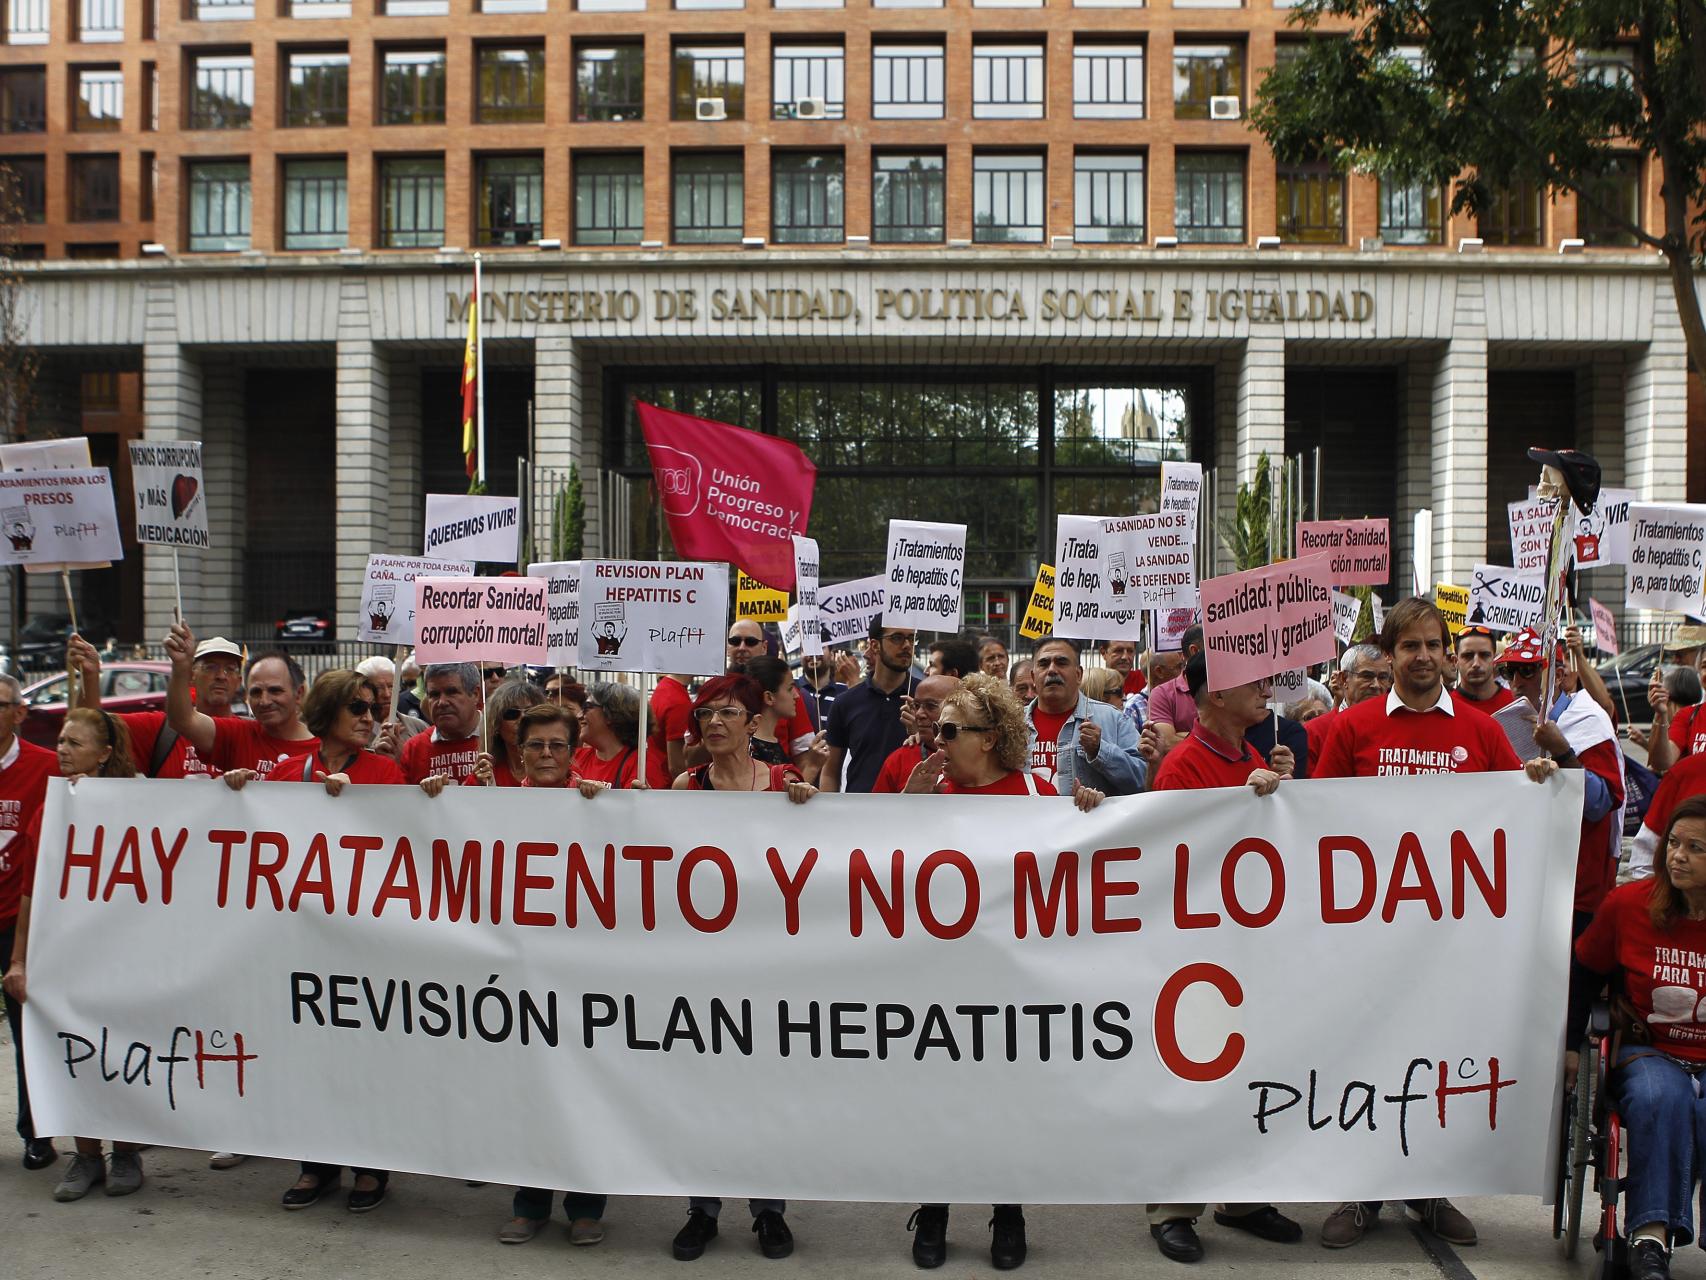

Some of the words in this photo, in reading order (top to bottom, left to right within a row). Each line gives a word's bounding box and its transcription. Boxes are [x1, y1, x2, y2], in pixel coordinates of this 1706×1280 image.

[446, 290, 642, 323] MNISTERIO
[654, 289, 698, 322] DE
[711, 289, 862, 325] SANIDAD,
[874, 289, 1028, 322] POLITICA
[1042, 289, 1163, 322] SOCIAL
[1174, 289, 1194, 321] E
[1206, 289, 1374, 323] IGUALDAD
[131, 447, 156, 467] MENOS
[61, 475, 85, 487] PARA
[88, 474, 106, 485] LOS
[712, 468, 761, 494] Unión
[24, 492, 74, 505] PRESOS
[147, 486, 167, 506] MÁS
[706, 486, 784, 522] Progreso
[789, 509, 801, 526] y
[1163, 496, 1170, 510] de
[1105, 522, 1115, 534] LA
[1116, 517, 1155, 533] SANIDAD
[1158, 516, 1173, 529] NO
[1175, 515, 1187, 527] SE
[1511, 509, 1524, 522] LA
[139, 523, 208, 547] MEDICACIÓN
[427, 515, 485, 552] ¡QUEREMOS
[486, 507, 517, 532] VIVIR!
[1301, 529, 1343, 549] Recortar
[1345, 527, 1388, 549] Sanidad,
[1513, 525, 1520, 538] Y
[1523, 524, 1535, 537] LA
[1633, 519, 1704, 544] ¡Tratamientos
[893, 537, 963, 565] ¡Tratamientos
[1148, 535, 1189, 551] VENDE...
[1520, 539, 1541, 553] SON
[380, 560, 405, 569] PLAFHC
[406, 561, 421, 569] POR
[422, 562, 442, 571] TODA
[443, 563, 470, 573] ESPAÑA
[1135, 556, 1146, 568] LA
[1146, 553, 1190, 569] SANIDAD
[1353, 553, 1388, 572] mortal!
[1632, 547, 1645, 565] de
[1647, 547, 1690, 573] hepatitis
[1691, 549, 1702, 572] C,
[371, 569, 401, 581] CAÑA...
[595, 565, 661, 580] REVISION
[666, 566, 705, 581] PLAN
[891, 565, 905, 583] de
[906, 567, 948, 592] hepatitis
[950, 569, 961, 593] C,
[1061, 567, 1075, 588] de
[1130, 575, 1142, 591] SE
[1143, 572, 1191, 590] DEFIENDE
[606, 587, 682, 604] HEPATITIS
[686, 590, 697, 604] C
[1276, 573, 1331, 612] pública,
[1437, 587, 1463, 605] Hepatitis
[1630, 576, 1646, 597] ya,
[1647, 576, 1668, 596] para
[1669, 574, 1701, 598] tod@s!
[422, 585, 484, 612] Recortar
[486, 586, 545, 616] Sanidad,
[739, 600, 785, 616] MATAN.
[888, 595, 903, 614] ya,
[903, 595, 924, 617] para
[926, 594, 959, 619] tod@s!
[1059, 600, 1073, 623] ya,
[1075, 601, 1099, 623] para
[1486, 605, 1525, 627] CRIMEN
[420, 619, 493, 653] corrupción
[496, 622, 545, 647] mortal!
[831, 616, 864, 640] CRIMEN
[1208, 624, 1268, 656] universal
[1271, 628, 1280, 659] y
[1282, 609, 1331, 657] gratuita!
[1378, 765, 1409, 777] PARA
[59, 823, 189, 905] HAY
[207, 830, 739, 934] TRATAMIENTO
[766, 847, 818, 935] Y
[848, 849, 981, 940] NO
[1013, 846, 1141, 940] ME
[1174, 837, 1286, 931] LO
[1318, 828, 1507, 926] DAN
[1652, 965, 1690, 985] PARA
[290, 970, 557, 1047] REVISIÓN
[583, 992, 753, 1057] PLAN
[778, 999, 1133, 1062] HEPATITIS
[1155, 962, 1246, 1083] C
